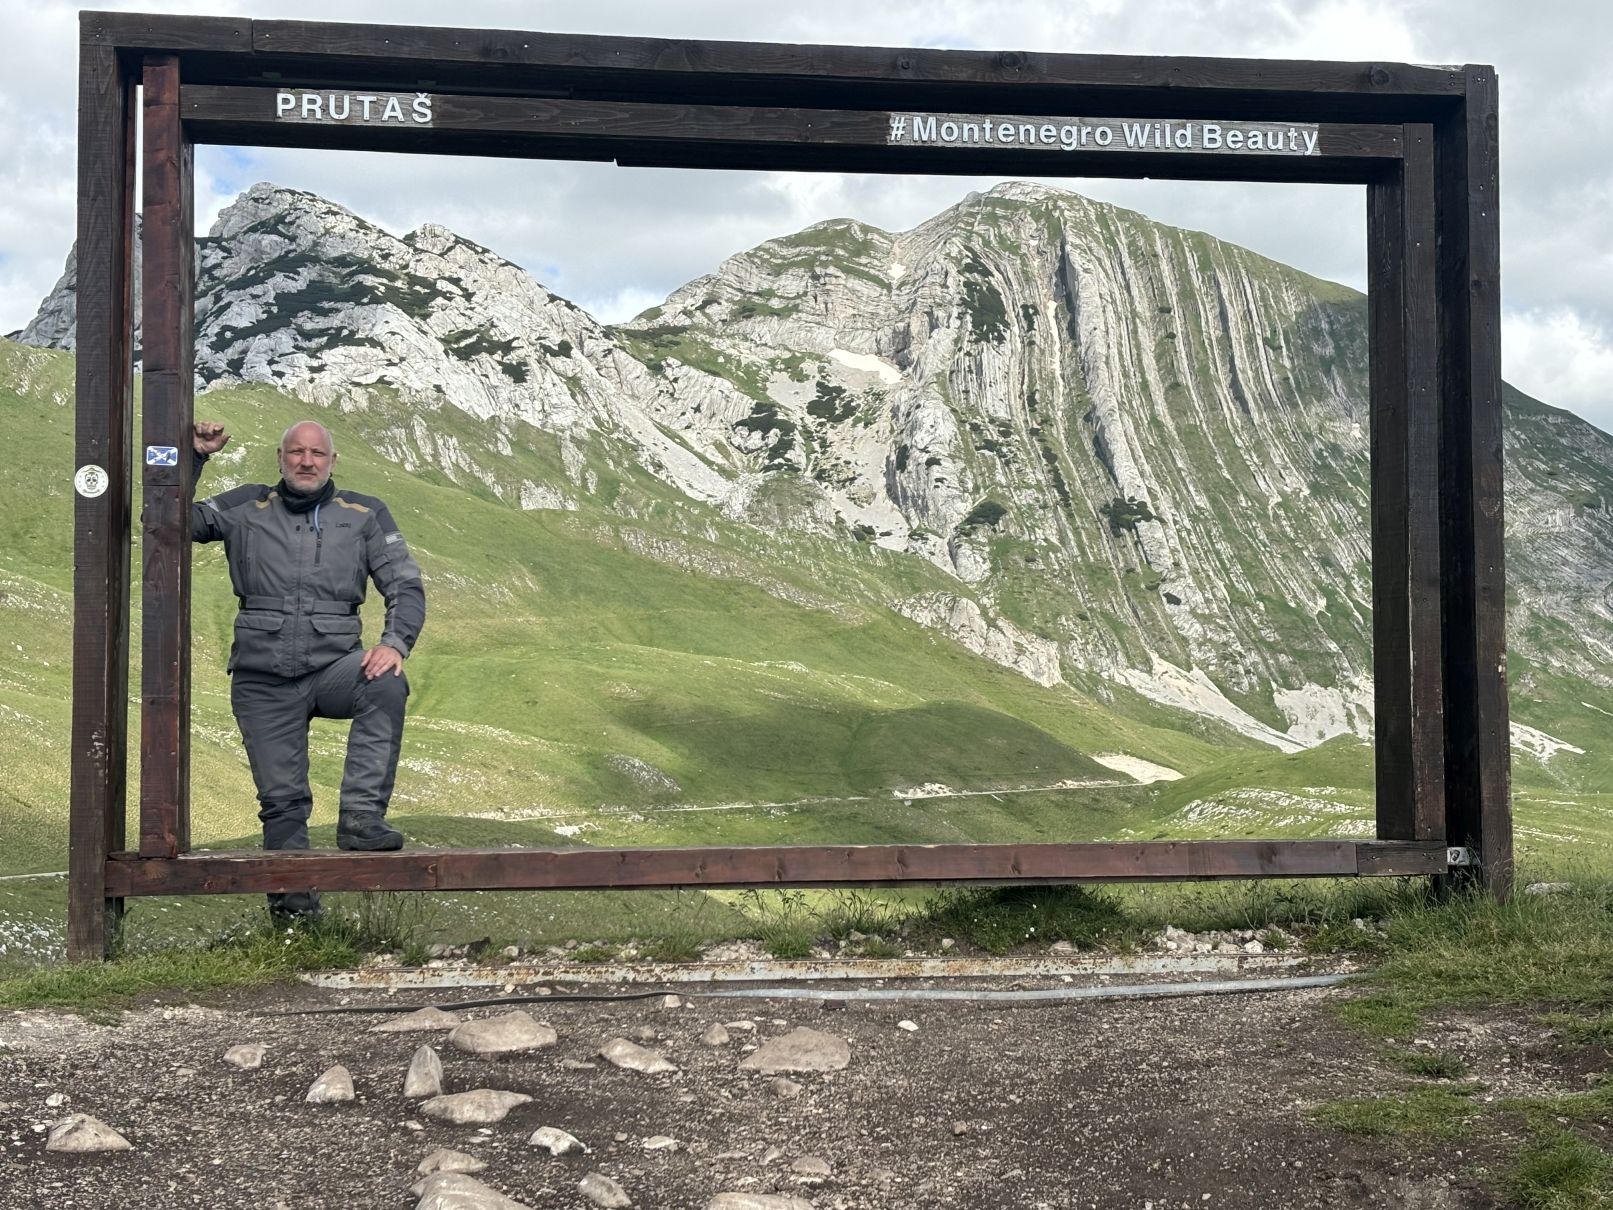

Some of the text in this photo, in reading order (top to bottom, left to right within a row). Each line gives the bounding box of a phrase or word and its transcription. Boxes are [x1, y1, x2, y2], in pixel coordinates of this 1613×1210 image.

[276, 92, 433, 124] PRUTAŠ
[1121, 122, 1193, 149] Wild
[1202, 124, 1319, 156] Beauty
